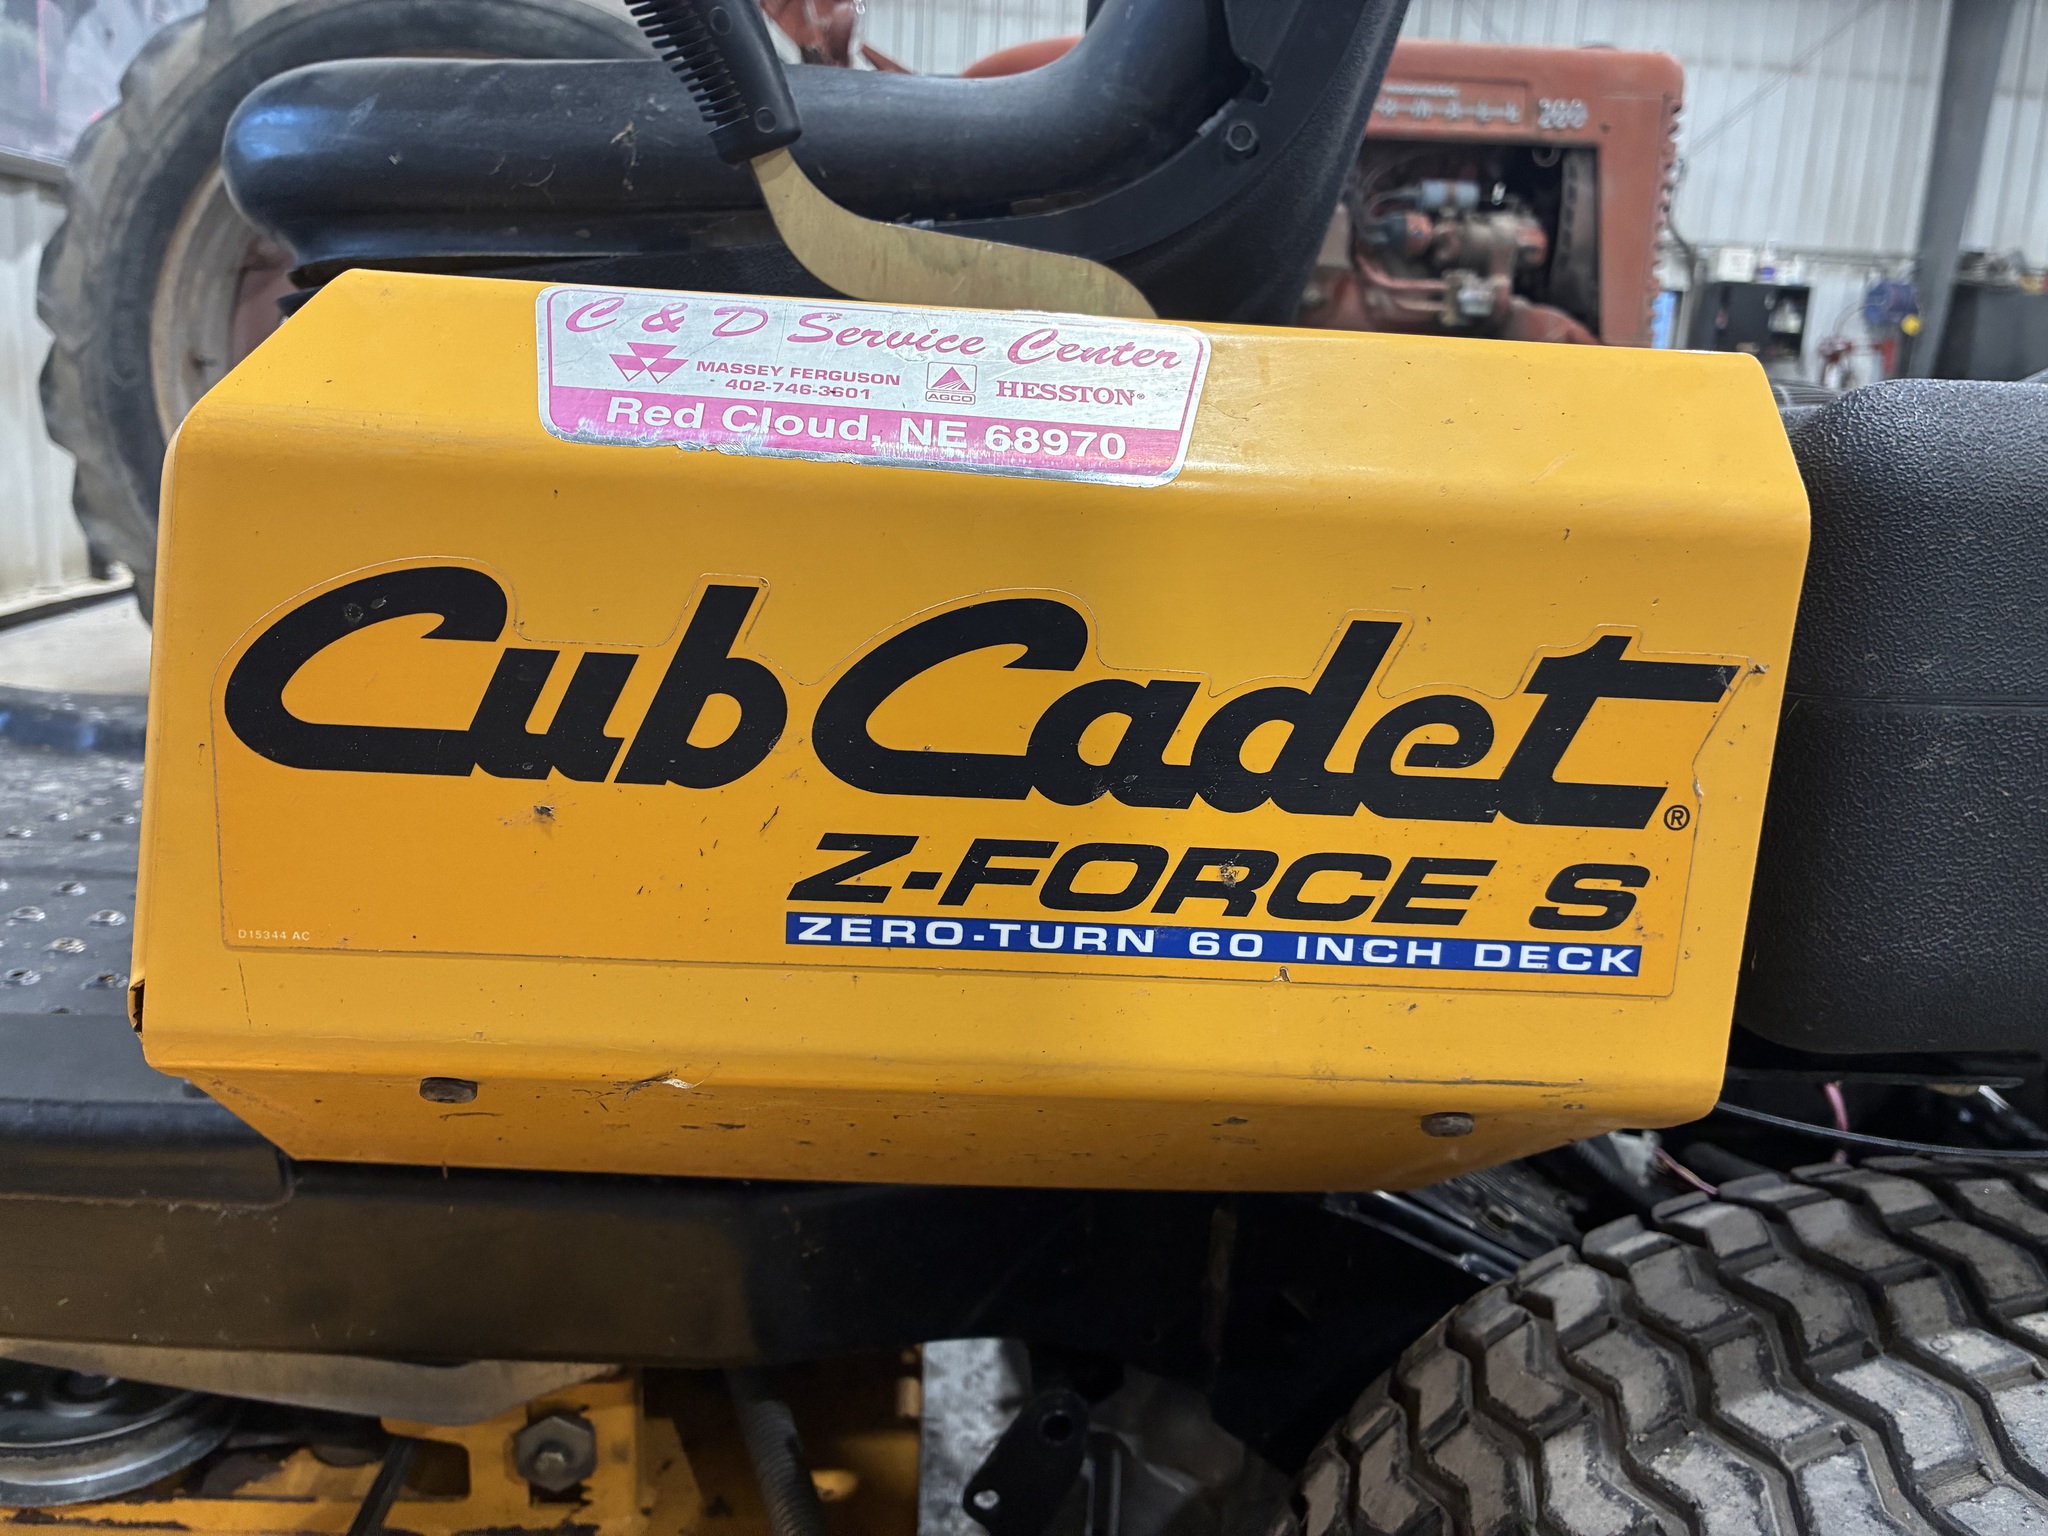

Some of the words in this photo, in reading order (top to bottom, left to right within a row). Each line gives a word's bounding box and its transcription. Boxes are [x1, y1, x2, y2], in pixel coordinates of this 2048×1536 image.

[565, 296, 624, 332] C
[641, 302, 688, 334] &
[712, 305, 769, 338] D
[786, 311, 986, 355] Service
[1007, 327, 1182, 369] Center
[696, 360, 784, 377] MASSEY
[790, 366, 900, 386] FERGUSON
[725, 378, 870, 400] 402-746-3601
[927, 393, 974, 403] AGCO
[605, 396, 705, 429] Red
[721, 404, 882, 448] Cloud,
[900, 416, 968, 449] NE
[985, 424, 1127, 460] 68970
[224, 566, 788, 789] Cub
[786, 832, 1498, 926] Z-FORCE
[1528, 862, 1651, 931] S
[238, 929, 287, 940] D15344
[292, 931, 310, 941] AC
[798, 916, 1155, 953] ZERO-TURN
[1188, 930, 1264, 958] 60
[1296, 936, 1442, 965] INCH
[1474, 943, 1636, 973] DECK
